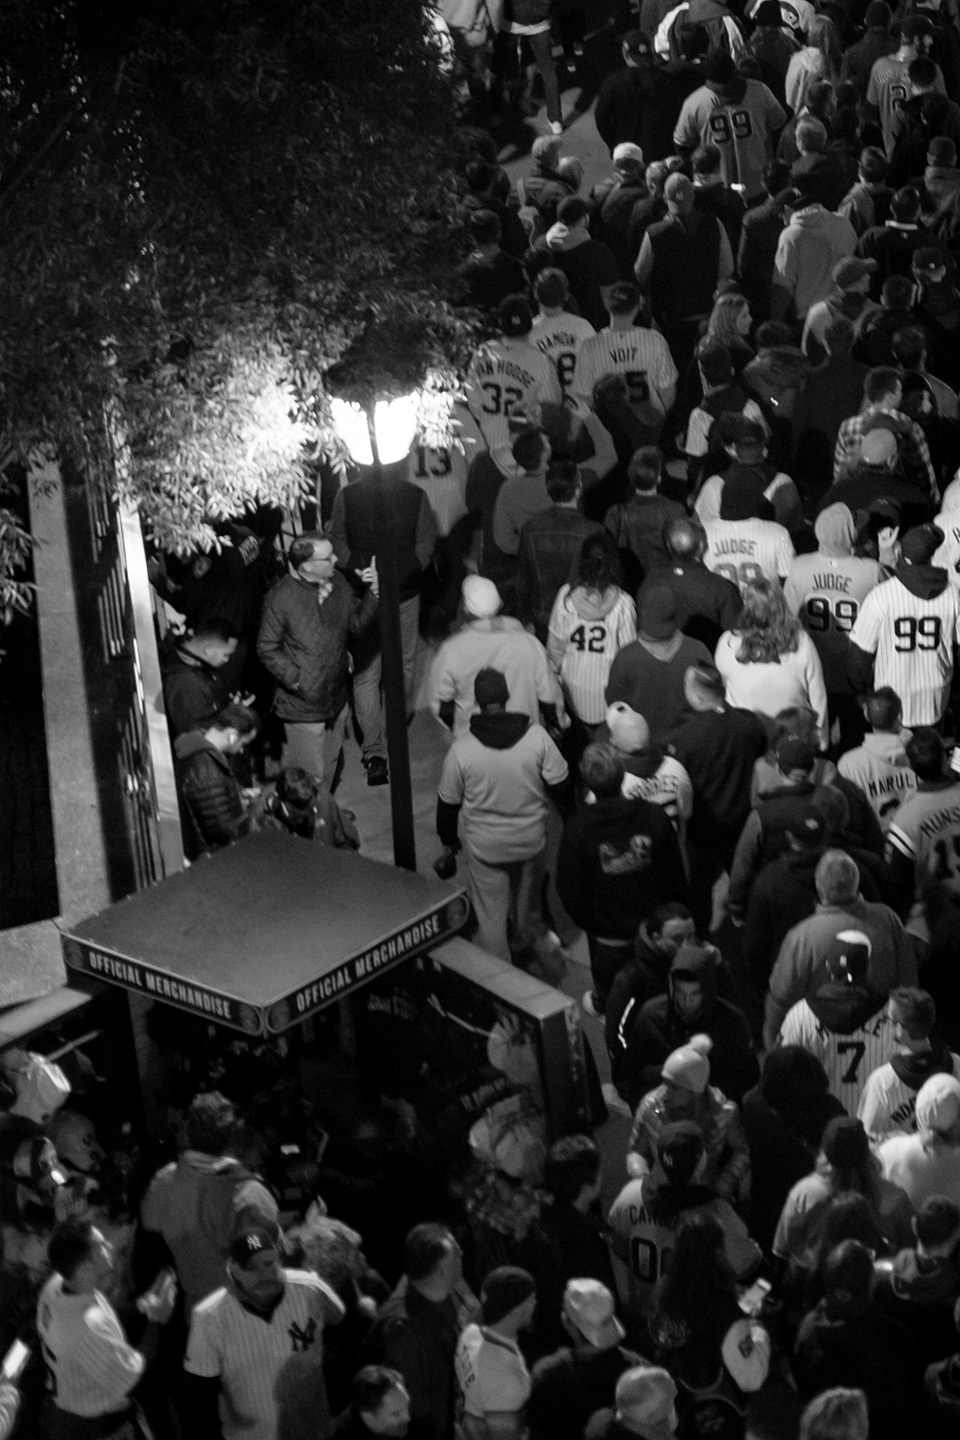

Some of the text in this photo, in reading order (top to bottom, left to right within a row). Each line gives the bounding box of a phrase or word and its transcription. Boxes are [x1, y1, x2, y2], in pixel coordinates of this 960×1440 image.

[710, 110, 752, 143] 99
[609, 346, 638, 365] VOIT
[482, 381, 523, 417] 32
[714, 537, 757, 558] JUDGE
[812, 571, 853, 595] JUDGE
[806, 596, 858, 633] 99
[570, 625, 607, 653] 42
[894, 615, 942, 653] 99
[296, 966, 352, 1013] OFFICIAL
[355, 913, 440, 979] MERCHANDISE
[89, 951, 232, 1020] OFFICIAL MERCHANDISE
[837, 1041, 865, 1083] 7
[246, 1234, 263, 1251] NY
[288, 1316, 317, 1353] NY
